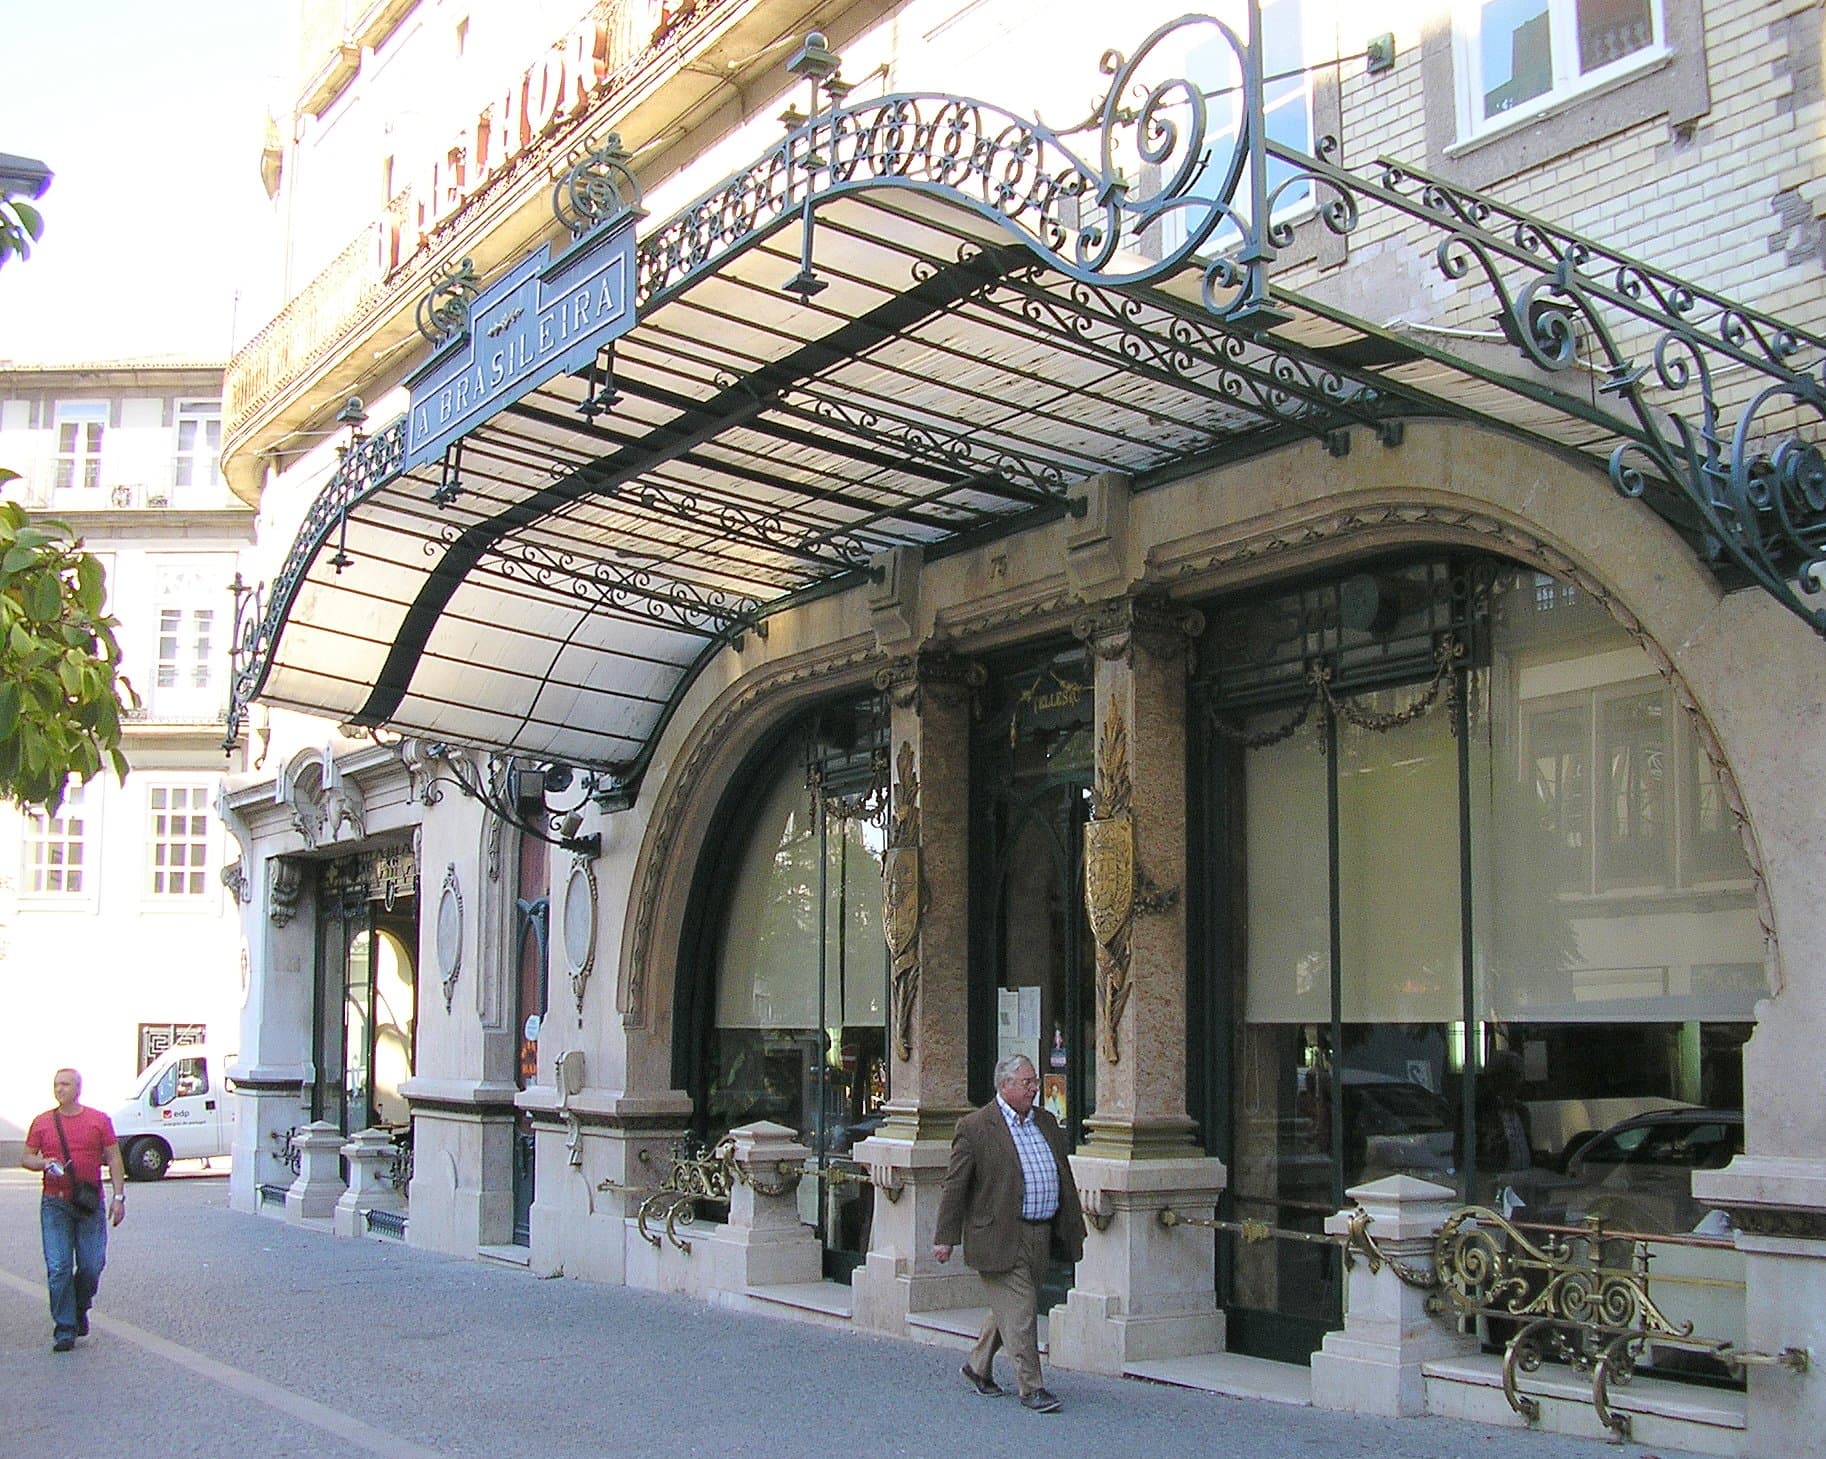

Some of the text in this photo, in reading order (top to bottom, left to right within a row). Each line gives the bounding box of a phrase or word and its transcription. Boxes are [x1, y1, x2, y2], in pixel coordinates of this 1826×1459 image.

[416, 277, 614, 441] A BRASILEIRA
[174, 1110, 190, 1118] edp
